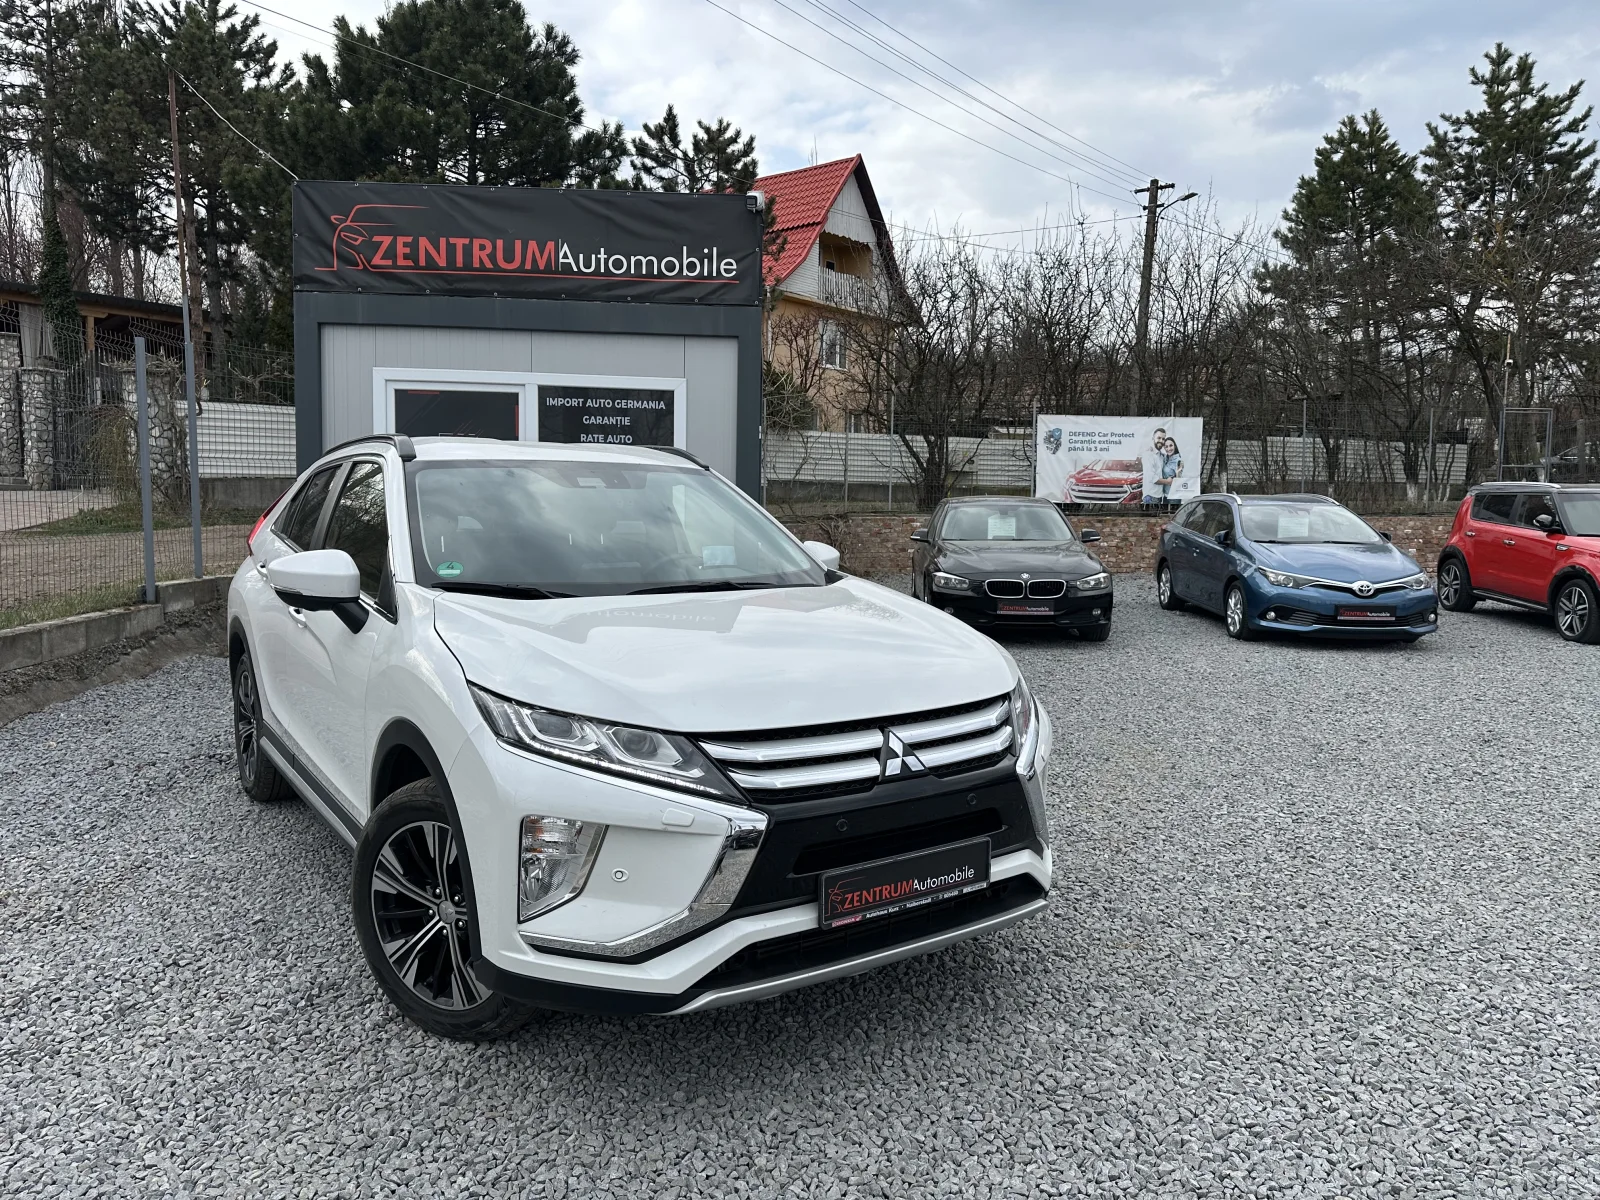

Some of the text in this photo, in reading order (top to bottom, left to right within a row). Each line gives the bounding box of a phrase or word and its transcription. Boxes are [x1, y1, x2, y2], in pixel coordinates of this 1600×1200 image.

[370, 235, 738, 277] ZENTRUM Automobile
[546, 397, 666, 410] IMPORT AUTO GERMANIA
[582, 415, 631, 427] GARANȚIE
[580, 433, 633, 444] RATE AUTO
[1068, 438, 1097, 446] Garanție
[446, 561, 455, 570] 4
[843, 866, 975, 909] ZENTRUM Automobile
